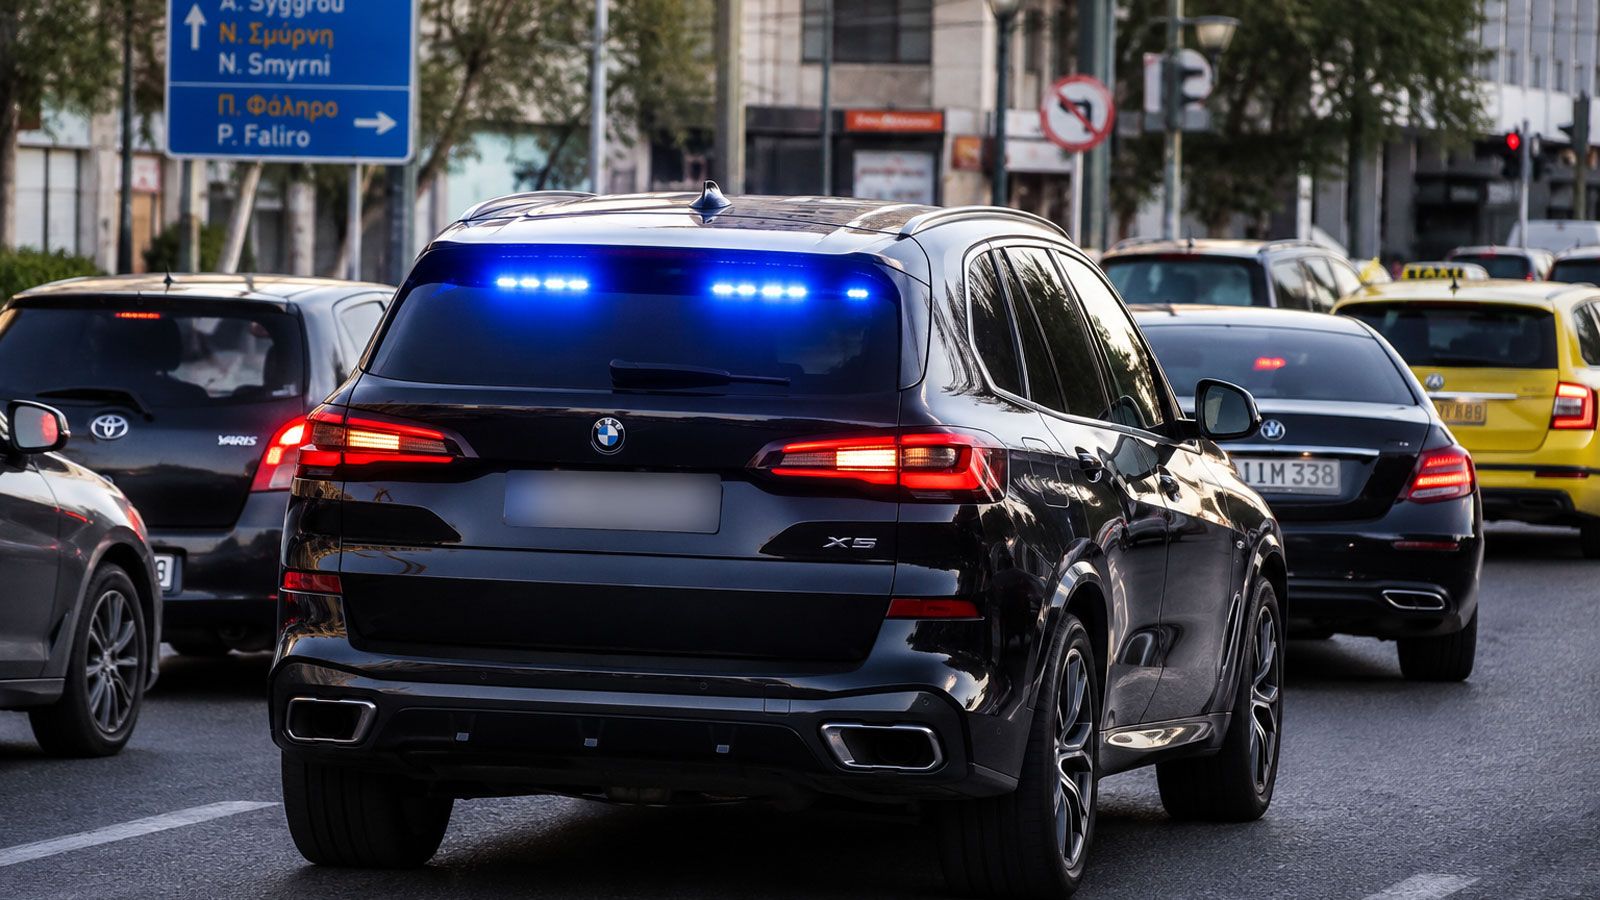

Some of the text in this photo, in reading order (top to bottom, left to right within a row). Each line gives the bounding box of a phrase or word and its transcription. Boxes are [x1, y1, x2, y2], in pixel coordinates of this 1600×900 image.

[220, 0, 344, 18] A. Syggrou
[248, 22, 334, 49] Σμύρνη
[219, 52, 331, 80] N. Smyrni
[218, 94, 338, 123] Π. Φάληρο
[218, 124, 311, 147] P. Faliro
[1408, 265, 1461, 279] TAXI
[218, 434, 258, 446] YARIS
[1292, 462, 1335, 486] 338
[822, 536, 877, 549] X5
